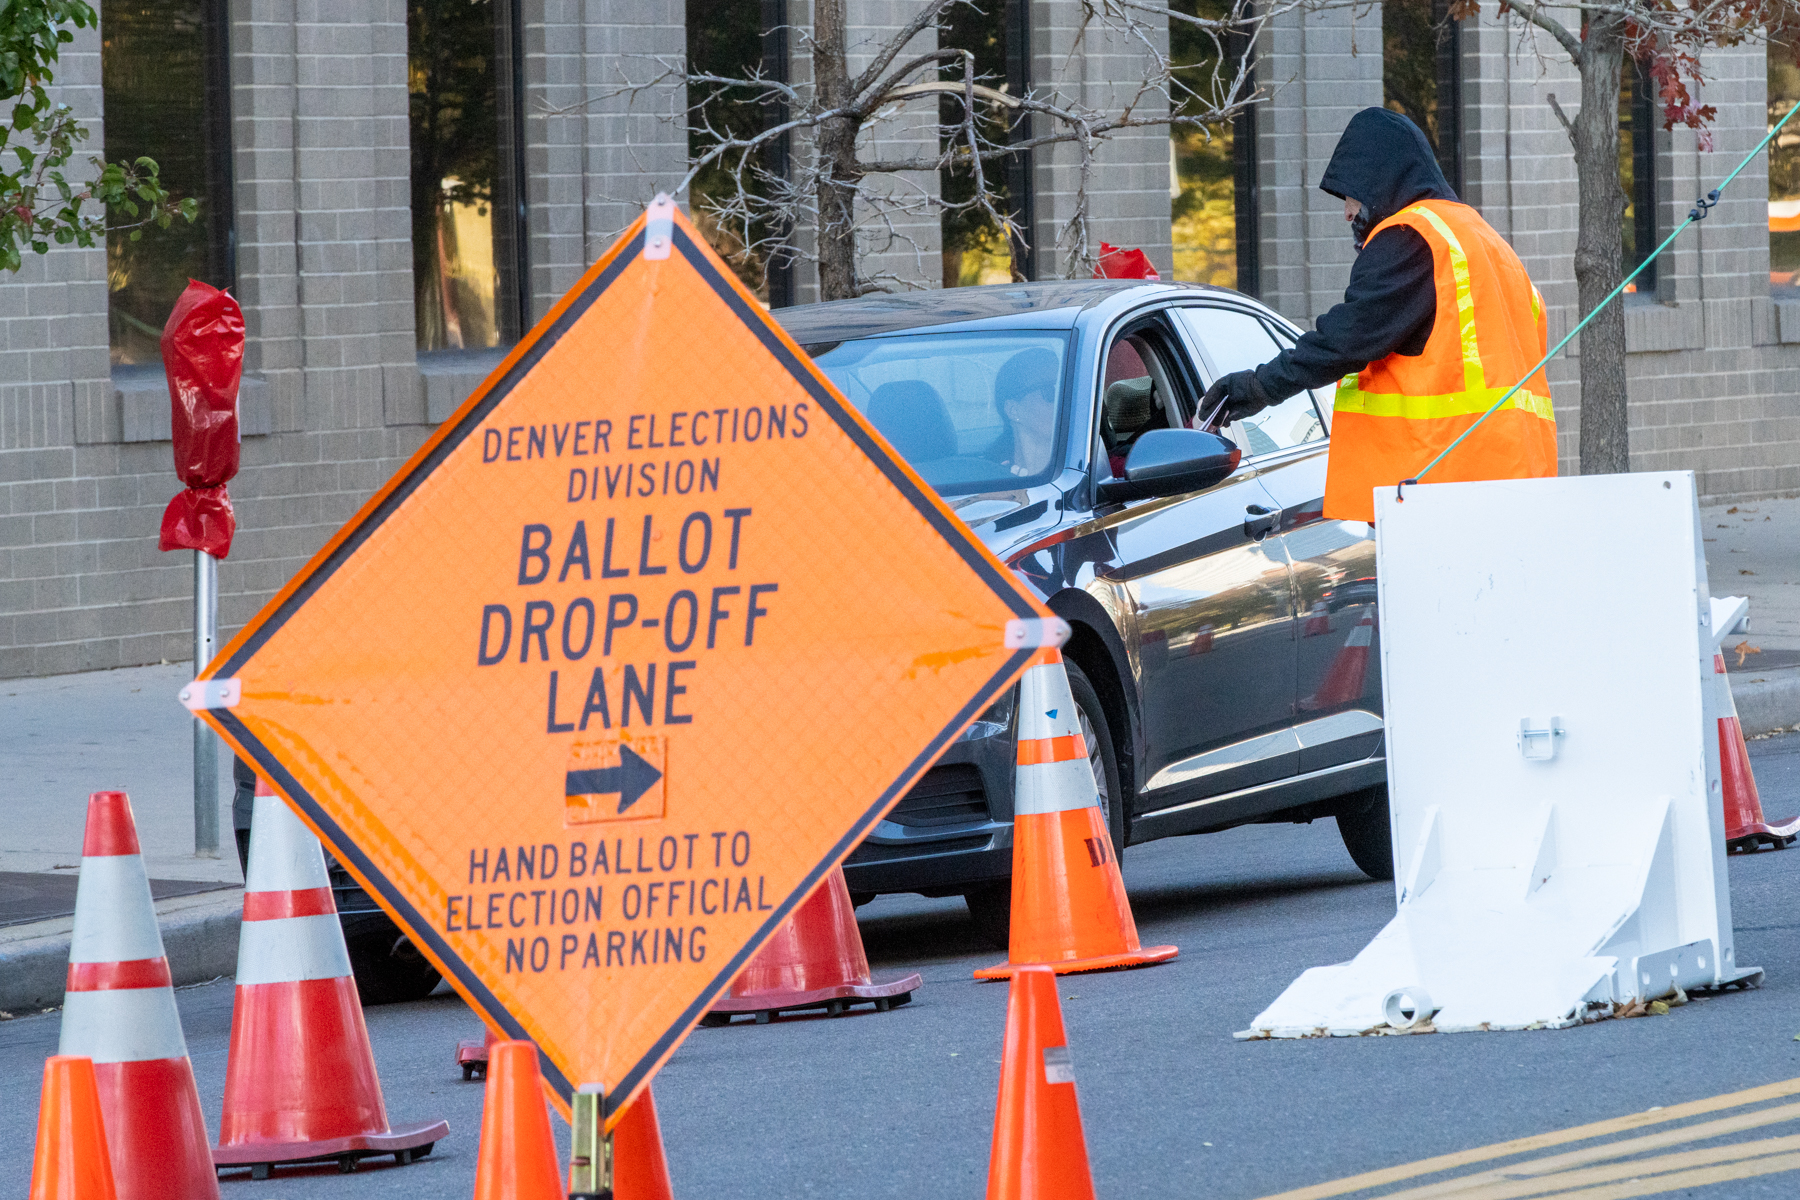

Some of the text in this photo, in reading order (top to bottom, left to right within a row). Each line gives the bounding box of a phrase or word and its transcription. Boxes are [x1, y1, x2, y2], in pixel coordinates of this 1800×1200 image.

[483, 403, 809, 463] DENVER ELECTIONS
[568, 458, 720, 503] DIVISION
[518, 508, 753, 586] BALLOT
[478, 583, 779, 667] DROP-OFF
[547, 661, 697, 734] LANE
[469, 831, 751, 884] HAND BALLOT TO
[447, 876, 773, 932] ELECTION OFFICIAL
[505, 926, 707, 974] NO PARKING
